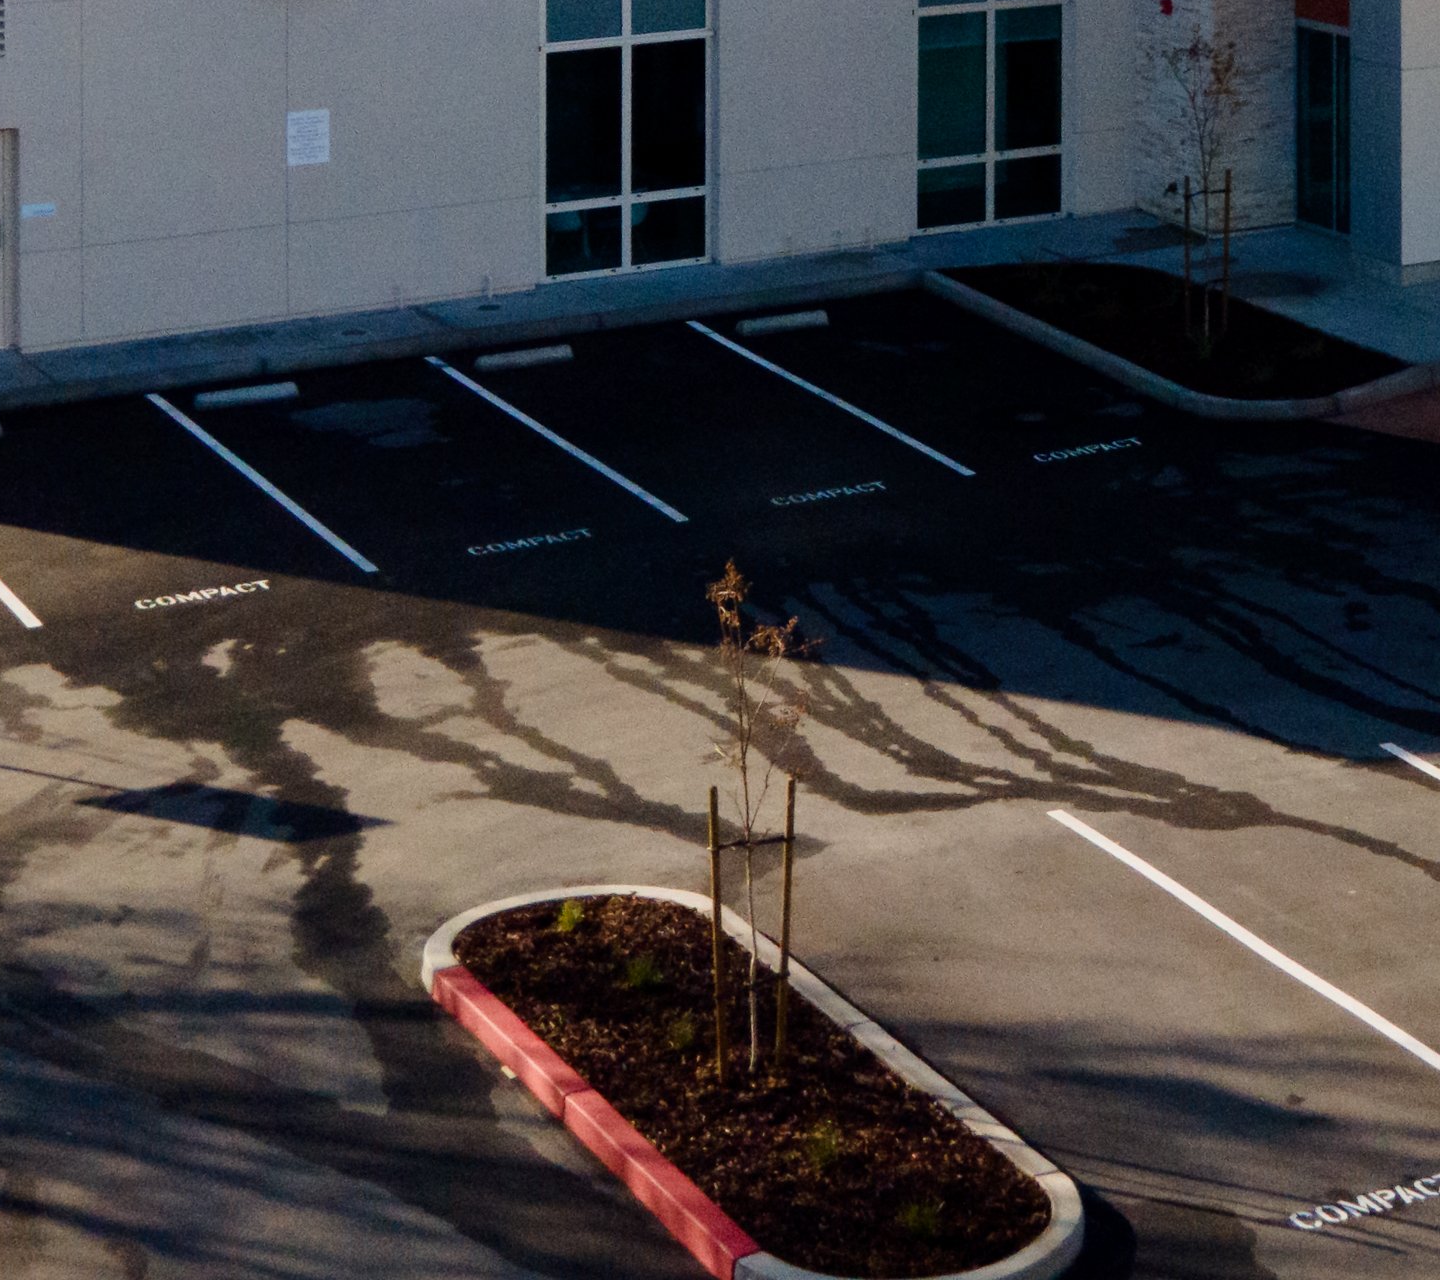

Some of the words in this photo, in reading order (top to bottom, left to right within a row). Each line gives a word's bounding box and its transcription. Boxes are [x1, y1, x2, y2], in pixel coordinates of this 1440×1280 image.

[1033, 436, 1143, 463] COMPACT
[770, 480, 887, 506] COMPACT
[467, 528, 592, 556] COMPACT
[134, 579, 270, 609] COMPACT
